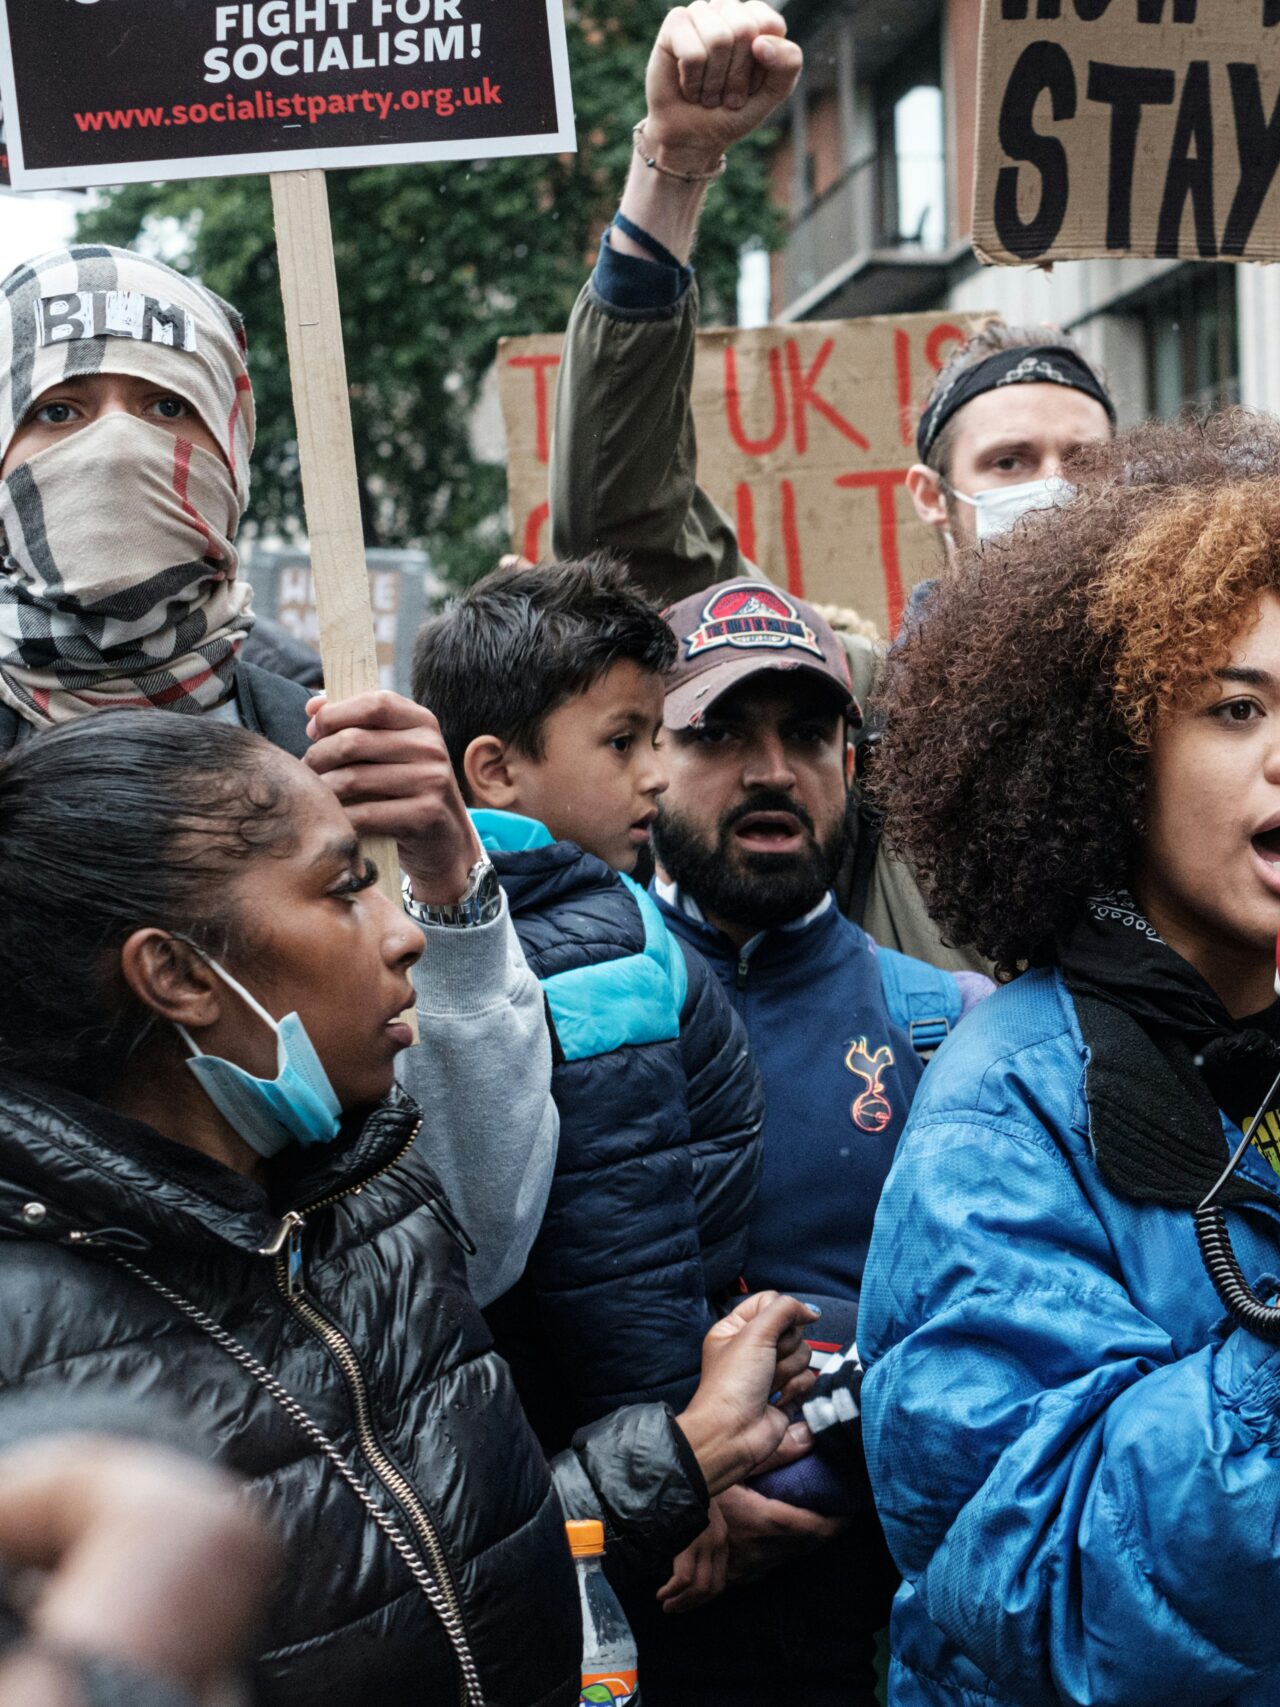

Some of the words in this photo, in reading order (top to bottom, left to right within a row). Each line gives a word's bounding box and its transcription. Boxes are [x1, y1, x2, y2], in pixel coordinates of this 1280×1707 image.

[215, 0, 350, 41] FIGHT
[371, 0, 463, 26] FOR
[203, 23, 482, 84] SOCIALISM!
[74, 77, 503, 132] www.socialistparty.org.uk
[40, 291, 186, 351] BLM
[723, 338, 871, 456] UK
